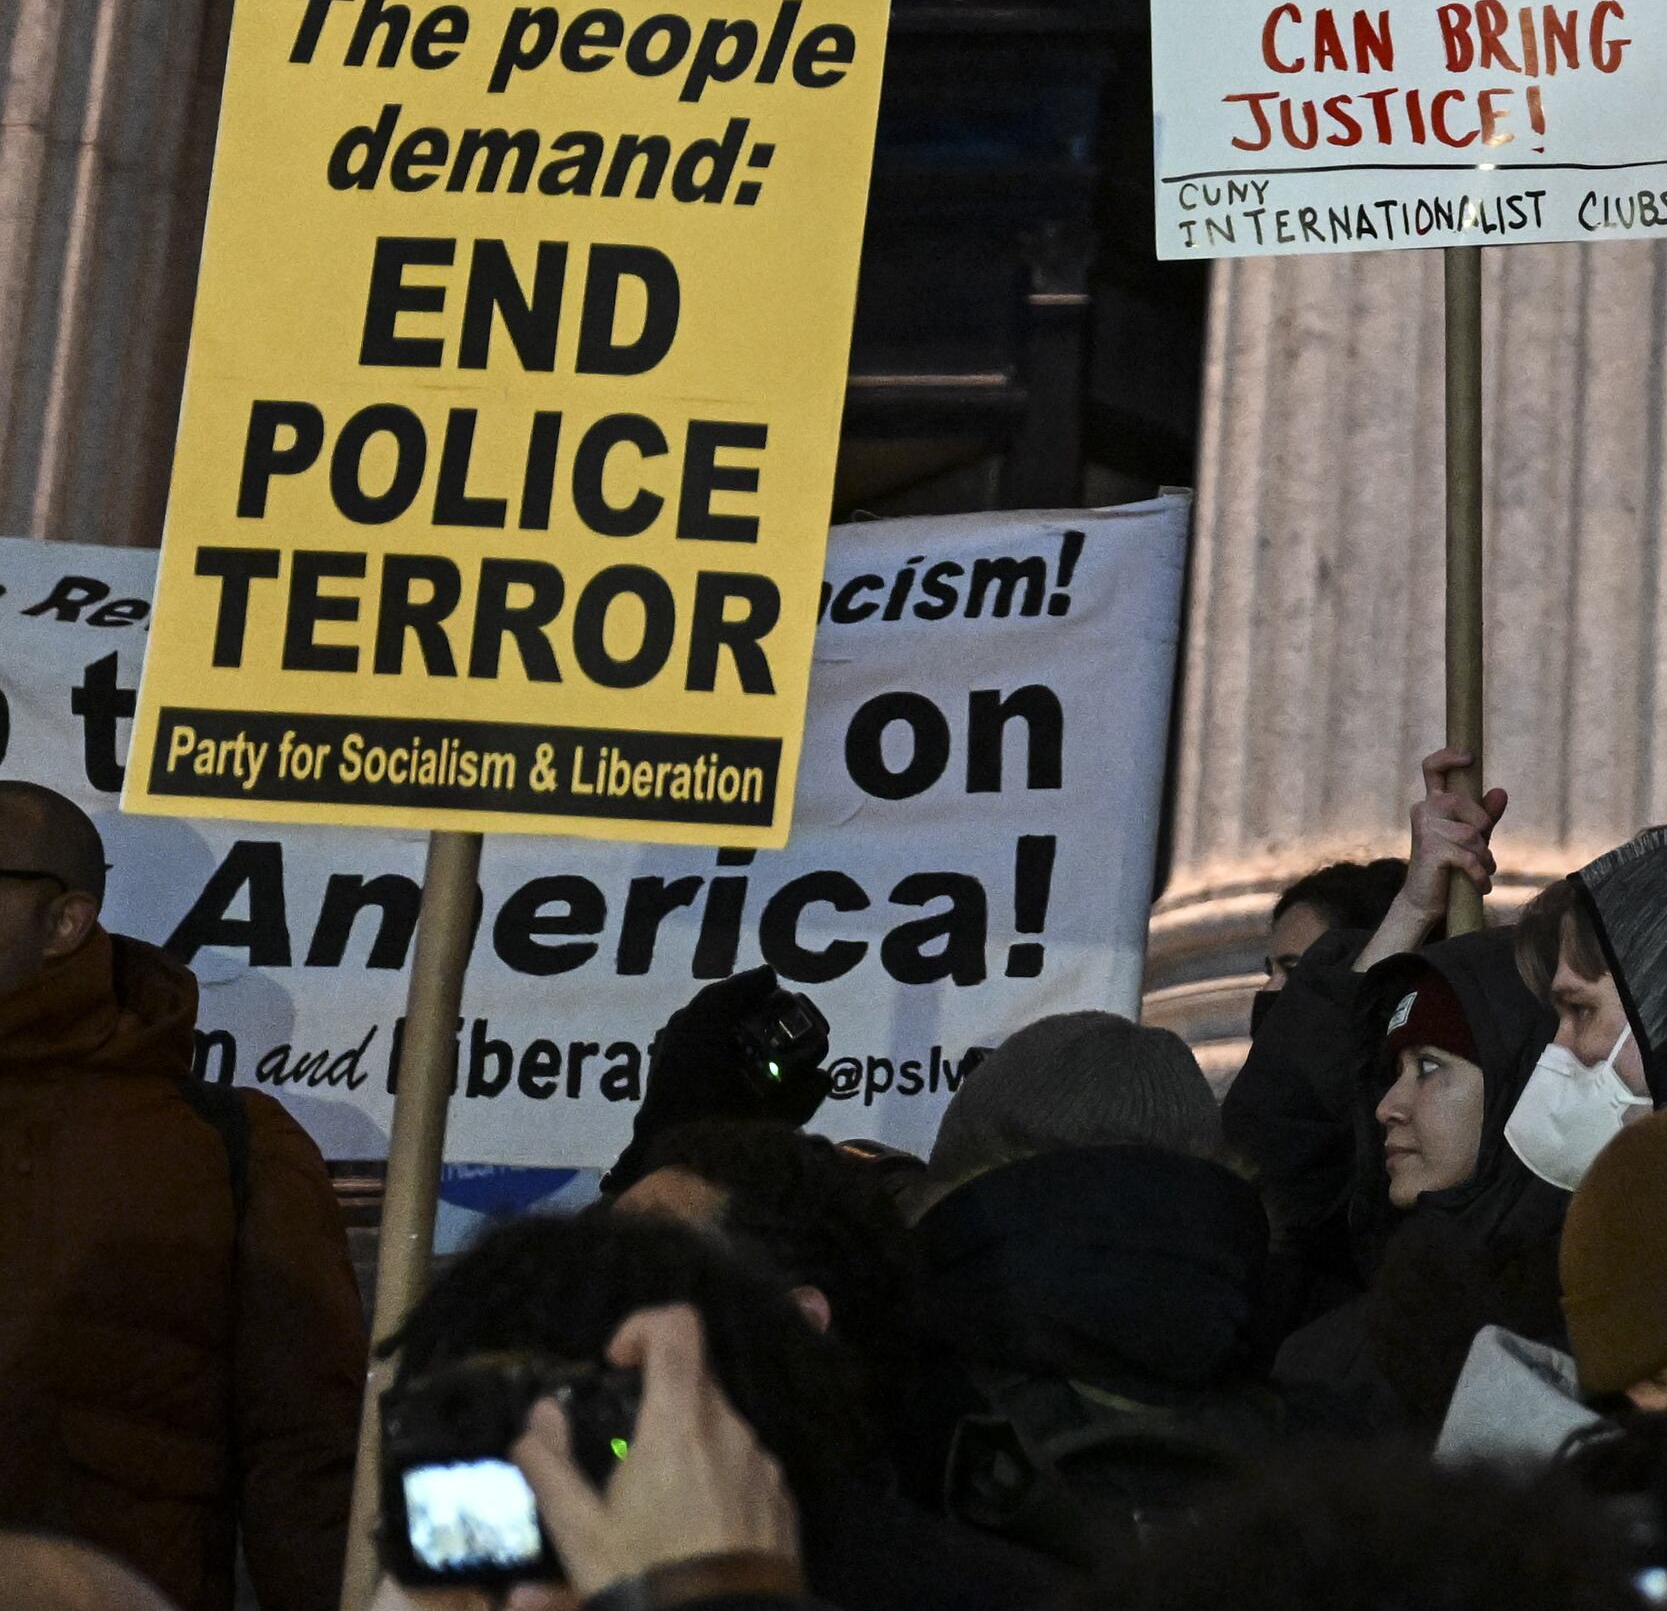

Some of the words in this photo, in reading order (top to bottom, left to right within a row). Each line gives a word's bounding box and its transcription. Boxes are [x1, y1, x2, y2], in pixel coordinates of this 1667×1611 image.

[487, 0, 856, 103] people
[1261, 3, 1393, 75] CAN
[1439, 0, 1633, 77] BRING
[326, 103, 775, 207] demand:
[1222, 86, 1546, 154] JUSTICE!
[1178, 178, 1271, 211] CUNY
[1178, 190, 1546, 248] INTERNATIONALIST
[358, 236, 680, 376] END
[236, 400, 769, 543] POLICE
[195, 546, 782, 695] TERROR
[818, 530, 1086, 624] cism!
[166, 726, 267, 788] Party
[278, 730, 331, 780] for
[339, 733, 516, 790] Socialism
[530, 747, 558, 791] &
[571, 749, 764, 804] Liberation
[845, 684, 1063, 800] on
[164, 833, 1059, 989] America!
[254, 1023, 379, 1093] and
